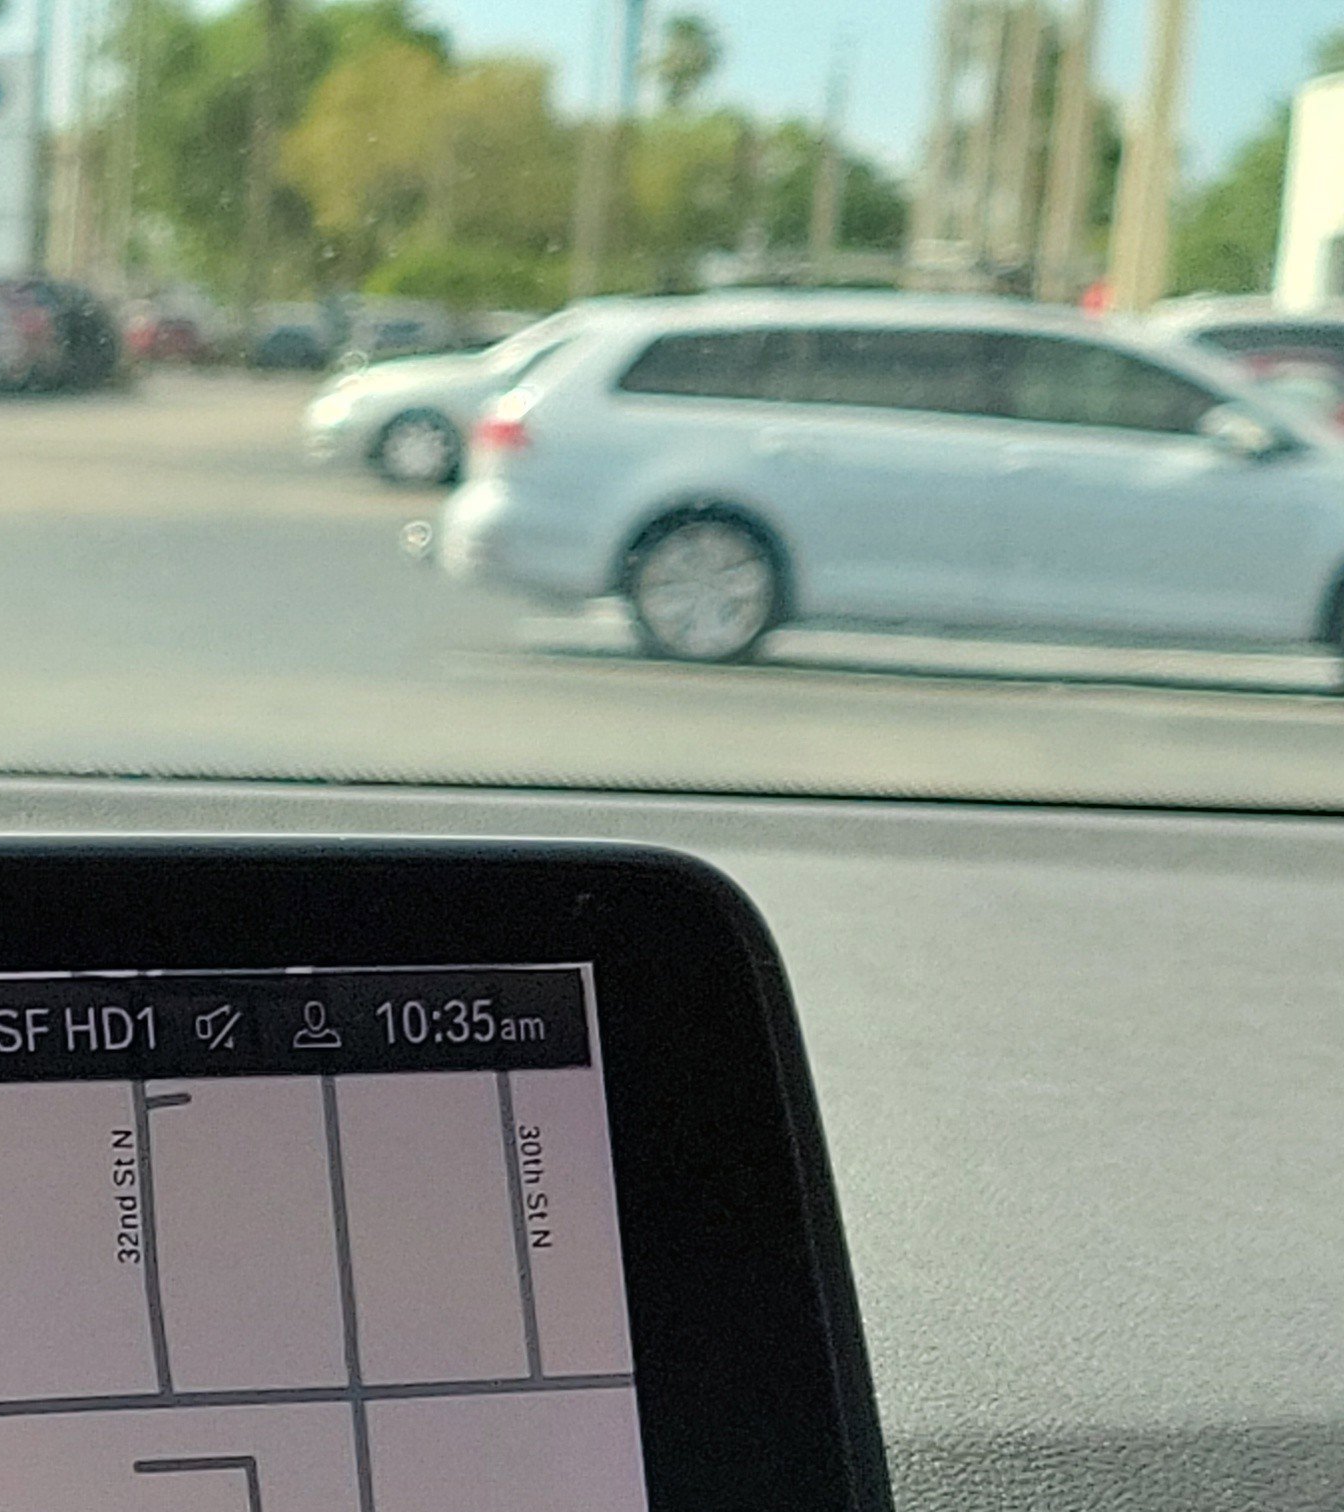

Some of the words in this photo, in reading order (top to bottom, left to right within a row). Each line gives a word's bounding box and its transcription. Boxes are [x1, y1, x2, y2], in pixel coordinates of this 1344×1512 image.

[64, 1005, 157, 1051] HD1
[111, 1130, 133, 1149] N
[518, 1125, 544, 1184] 30th
[113, 1158, 135, 1187] St
[527, 1192, 548, 1220] St
[114, 1196, 141, 1264] 32nd
[531, 1229, 552, 1248] N
